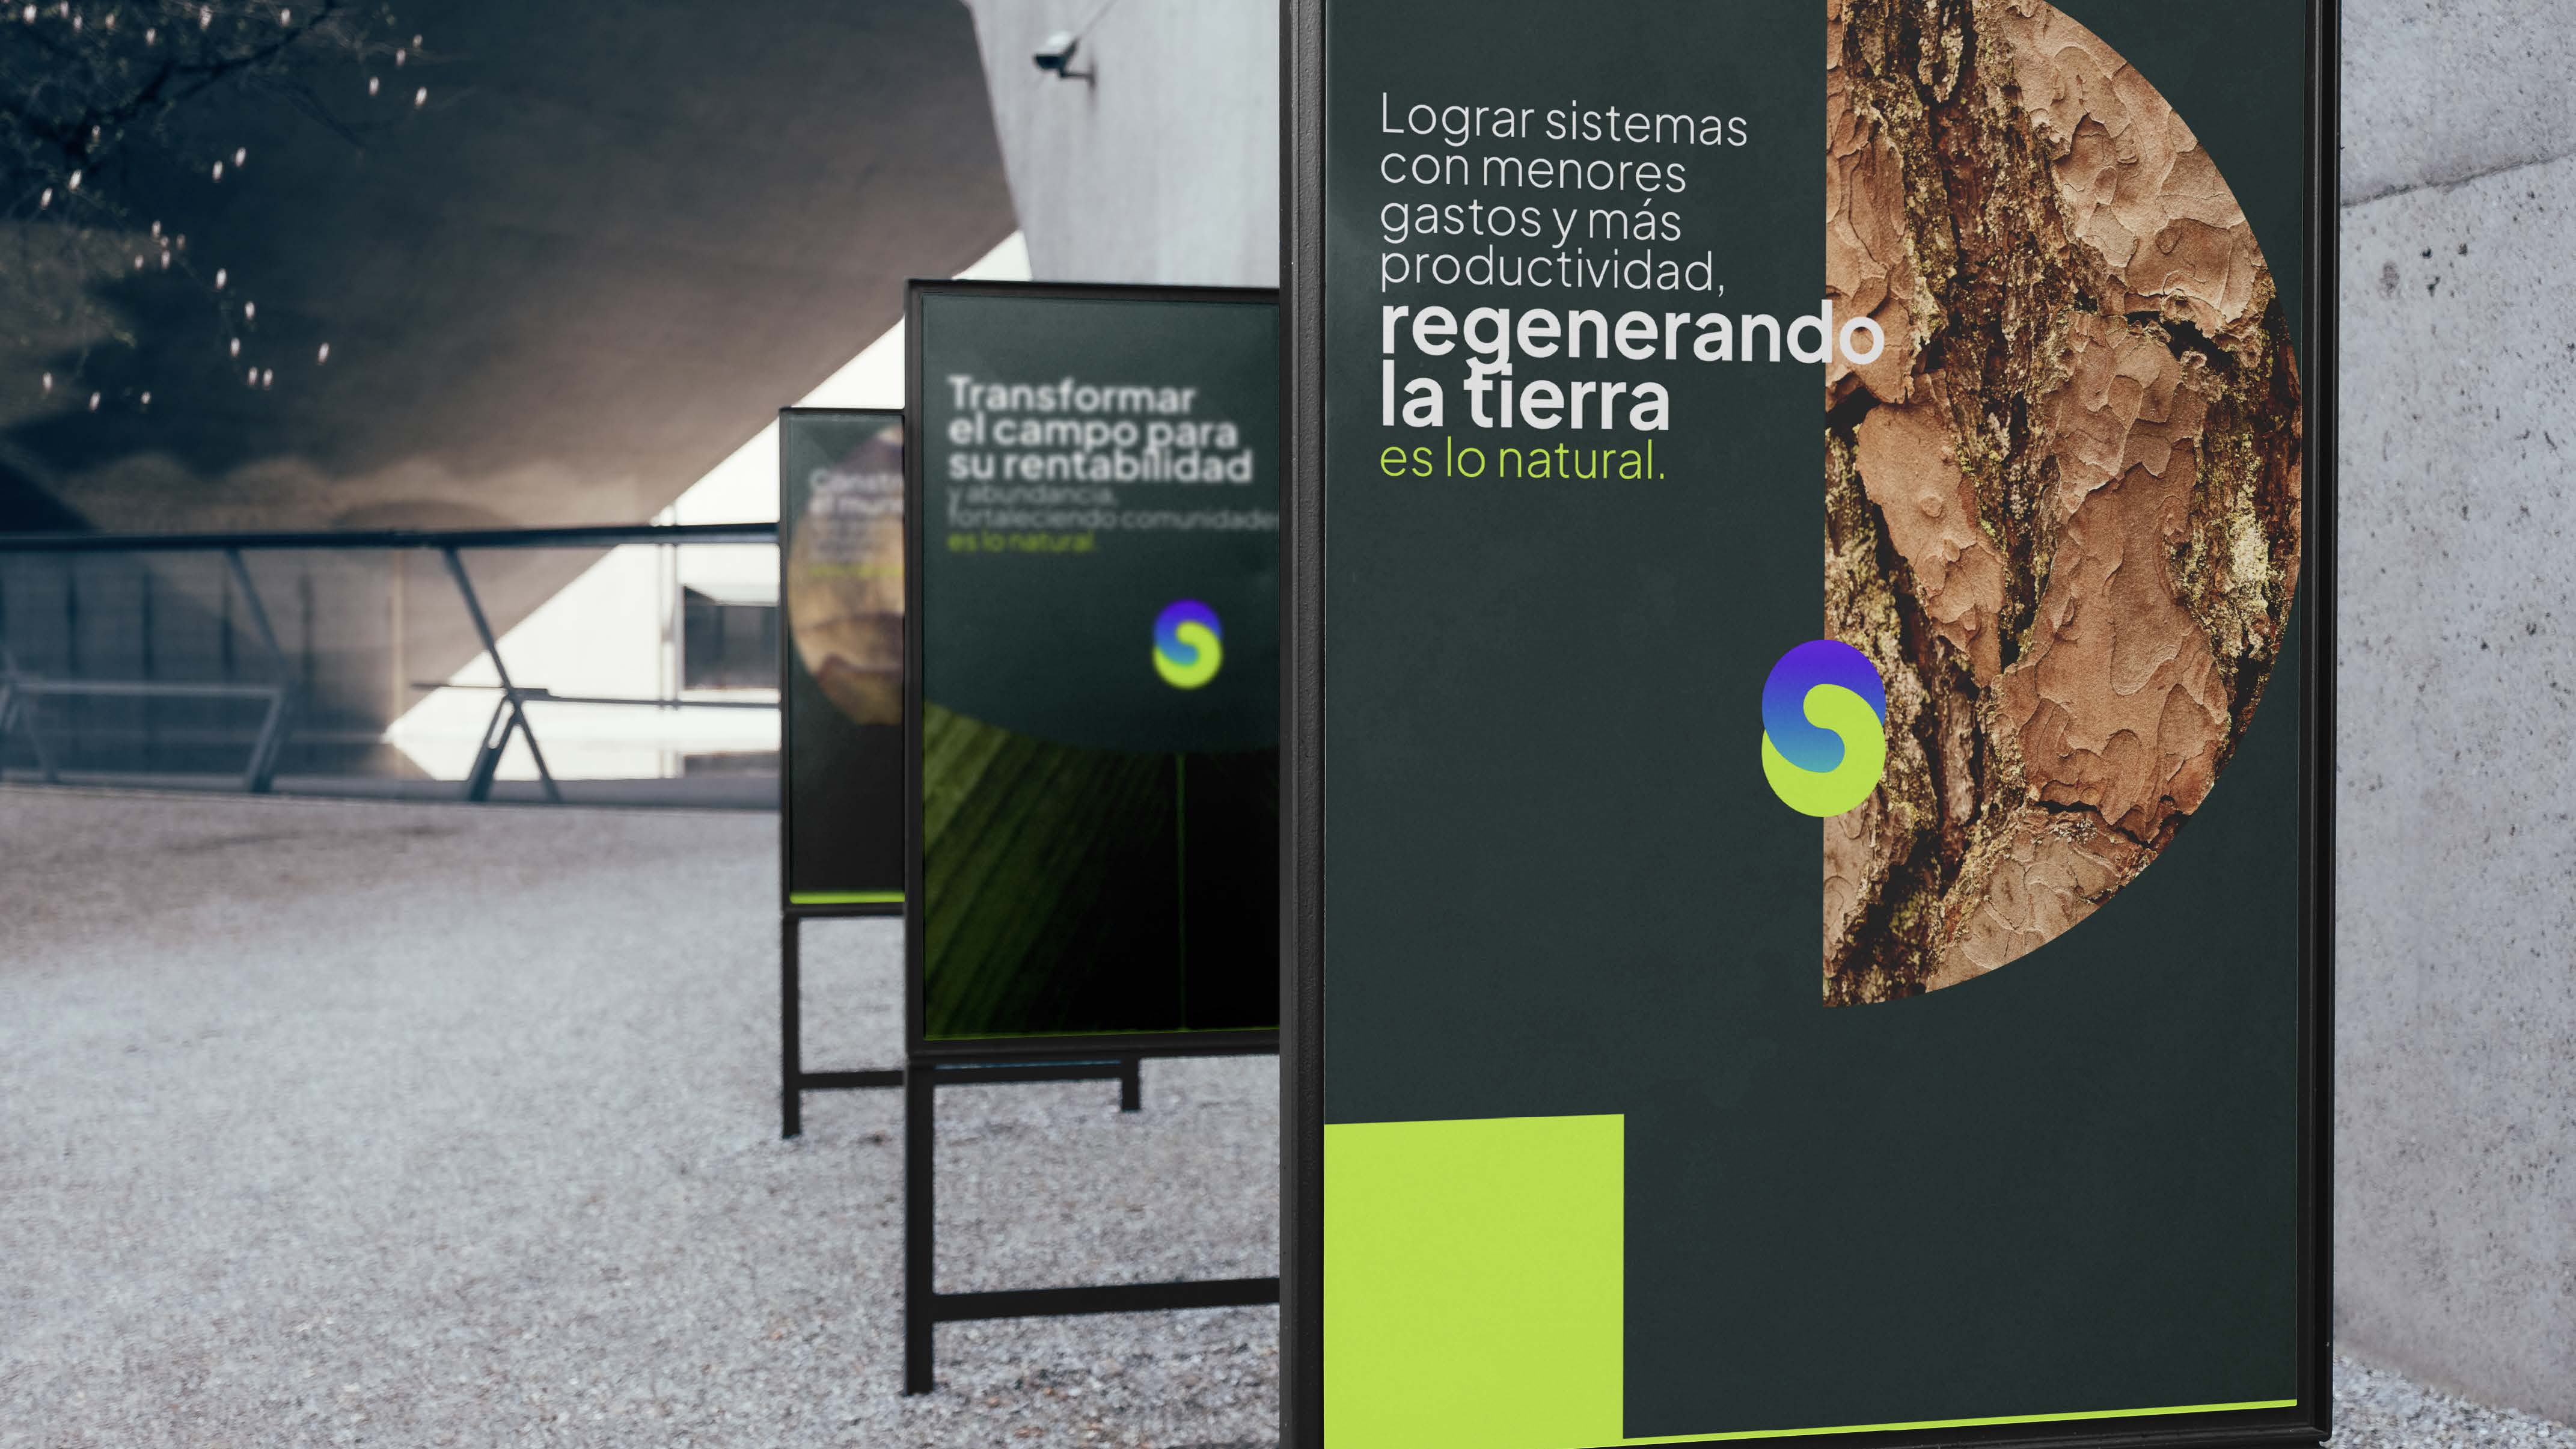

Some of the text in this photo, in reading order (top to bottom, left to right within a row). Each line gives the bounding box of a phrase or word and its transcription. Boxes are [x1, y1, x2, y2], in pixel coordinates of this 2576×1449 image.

[1382, 91, 1748, 147] Lograr sistemas
[1381, 153, 1686, 193] con menores
[1380, 198, 1681, 249] gastos y más
[1381, 244, 1725, 298] productividad,
[1382, 299, 1885, 376] regenerando
[947, 374, 1196, 415] Transformar
[1382, 360, 1670, 431] la tierra
[947, 410, 1238, 456] el campo para
[948, 447, 1253, 483] su rentabilidad
[1380, 436, 1665, 480] es lo natural.
